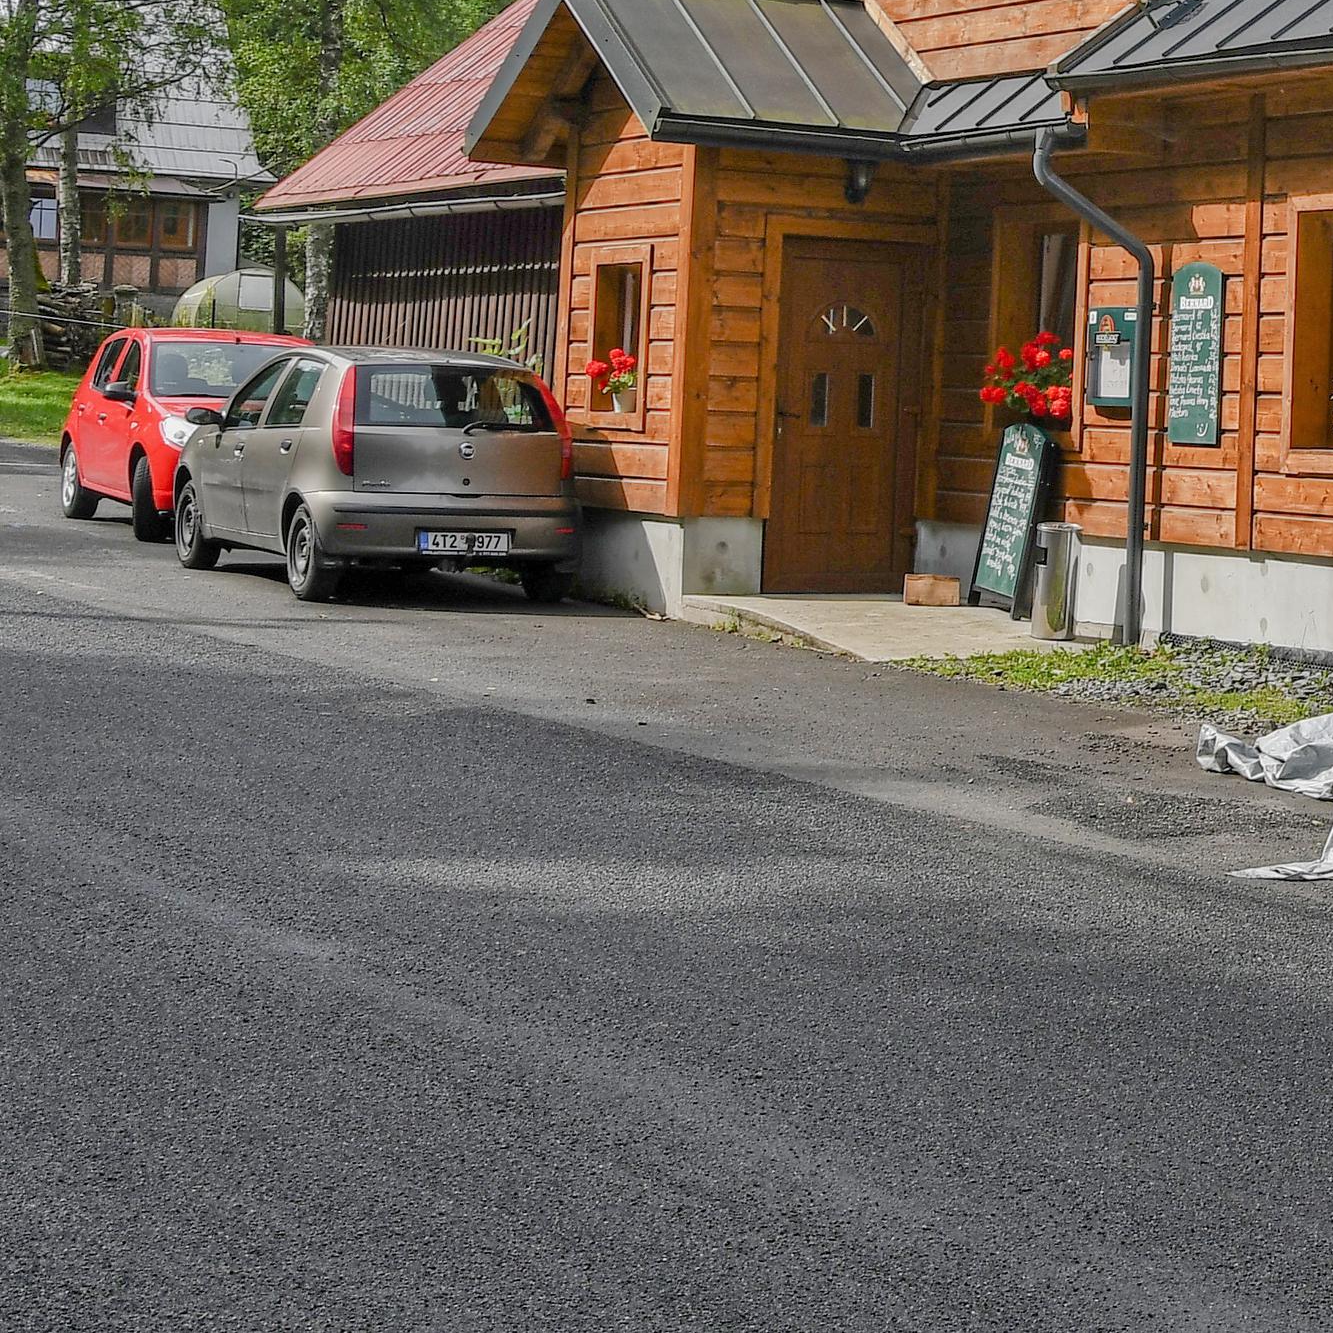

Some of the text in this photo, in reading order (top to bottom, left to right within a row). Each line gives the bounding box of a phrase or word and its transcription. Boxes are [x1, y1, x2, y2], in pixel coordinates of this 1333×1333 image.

[1179, 295, 1214, 310] BERNARD
[432, 534, 501, 549] 4T2 977
